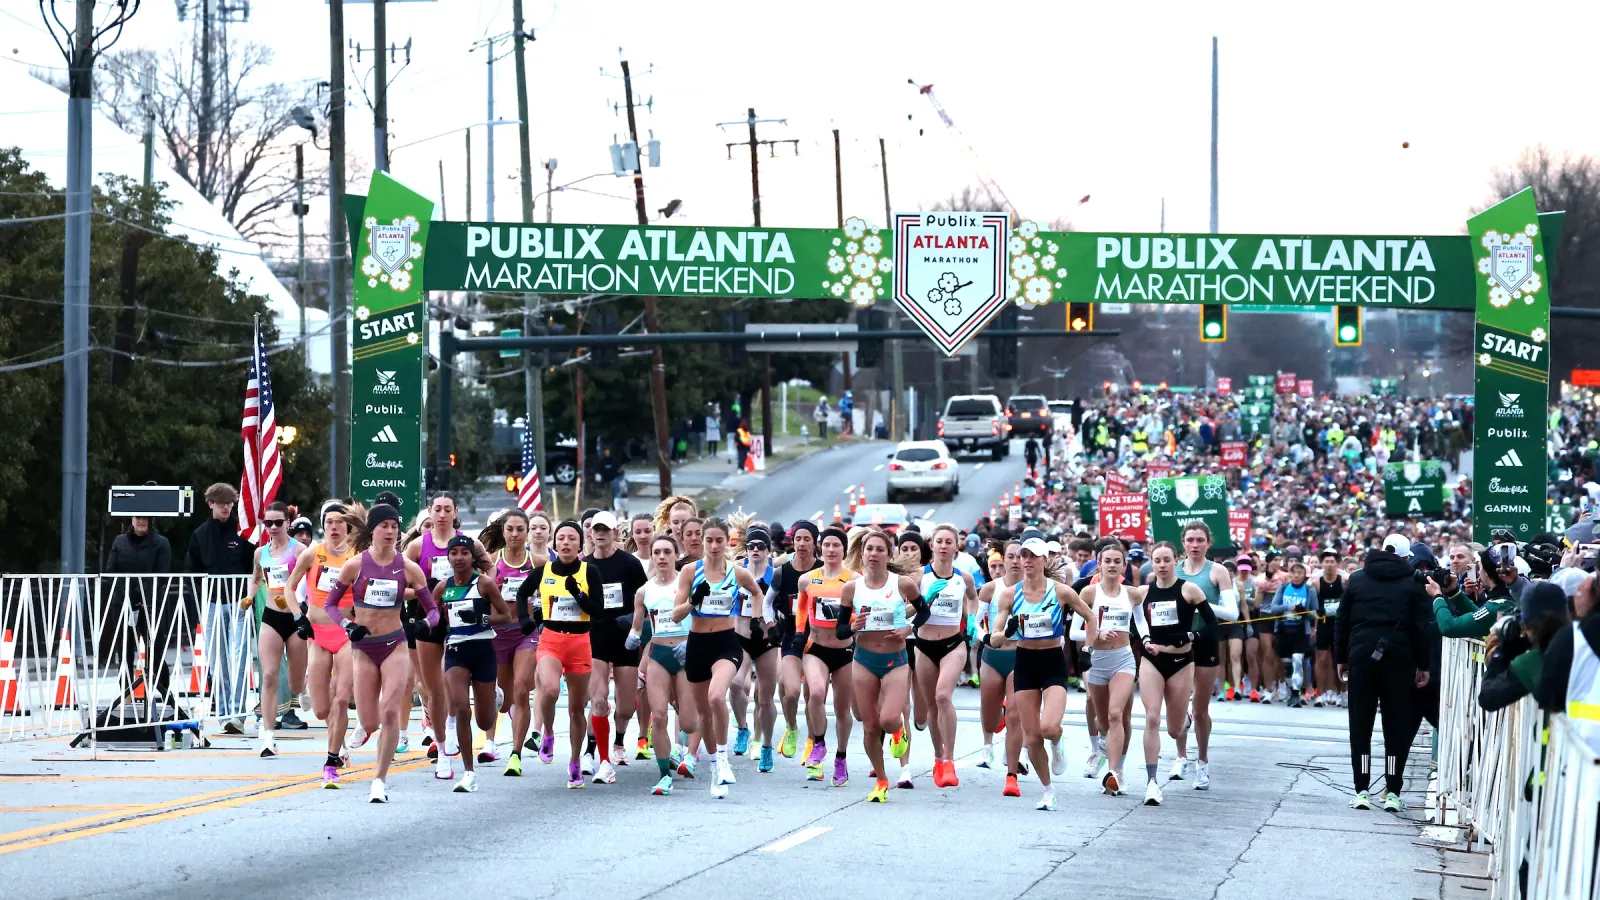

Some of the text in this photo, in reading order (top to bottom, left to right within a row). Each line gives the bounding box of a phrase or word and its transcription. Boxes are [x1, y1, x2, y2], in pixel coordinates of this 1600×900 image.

[926, 214, 976, 228] Publix
[466, 226, 795, 264] PUBLIX ATLANTA
[913, 235, 989, 249] ATLANTA
[1096, 237, 1436, 272] PUBLIX ATLANTA
[464, 262, 795, 295] MARATHON WEEKEND
[1094, 274, 1436, 304] MARATHON WEEKEND
[360, 312, 415, 340] START
[1481, 332, 1543, 362] START
[366, 404, 403, 414] Publix
[1488, 428, 1528, 438] Publix
[362, 480, 406, 488] GARMIN
[1408, 498, 1422, 512] A
[1484, 504, 1531, 513] GARMIN
[1105, 512, 1141, 529] 1:35
[1546, 516, 1565, 534] 13
